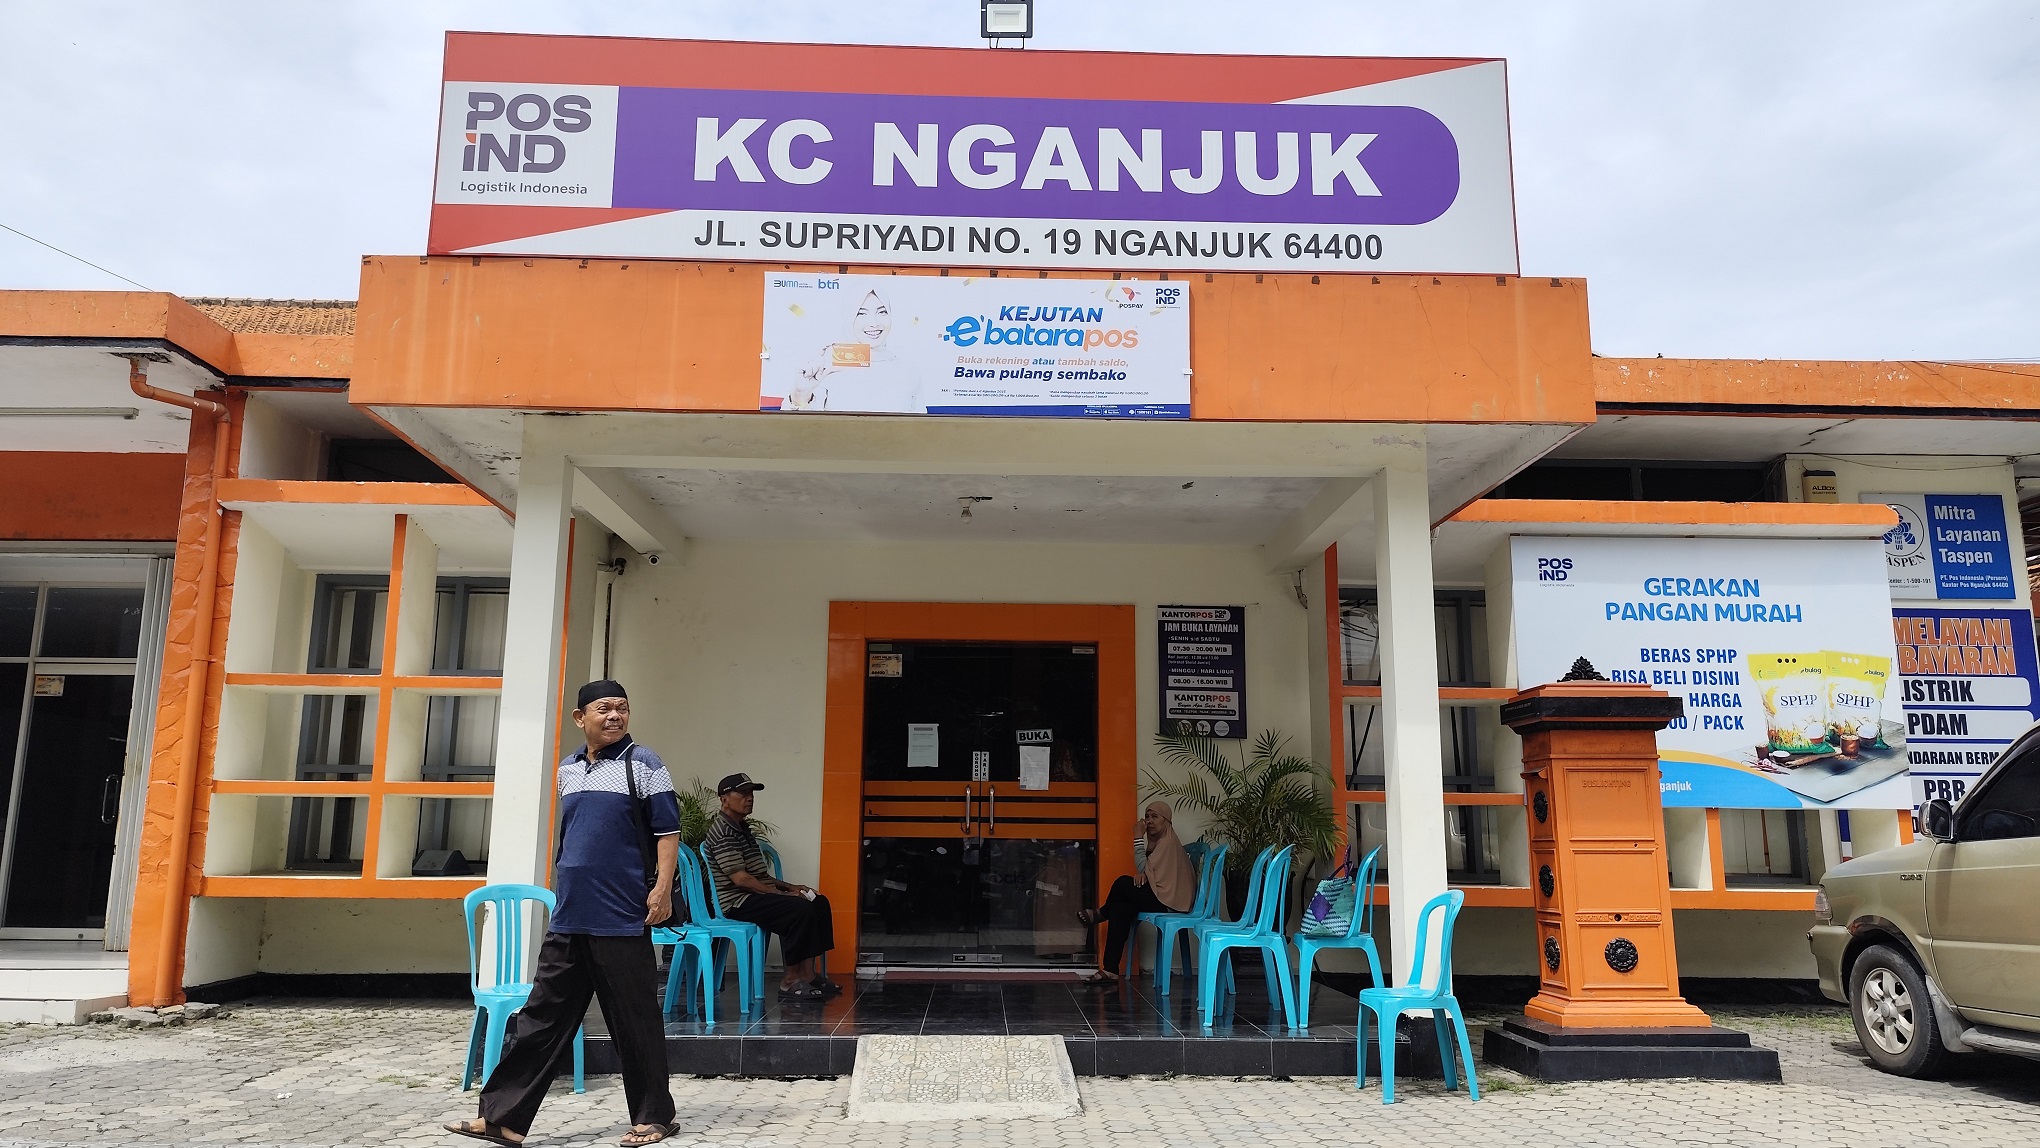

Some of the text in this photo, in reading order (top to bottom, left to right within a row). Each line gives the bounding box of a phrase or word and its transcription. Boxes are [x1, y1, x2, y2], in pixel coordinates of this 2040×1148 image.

[467, 91, 592, 134] POS
[693, 116, 1383, 198] KC NGANJUK
[460, 181, 588, 196] Logistik Indonesia
[693, 220, 1383, 261] JL. SUPRIYADI NO. 19 NGANJUK 64400
[1155, 288, 1181, 297] POS
[999, 305, 1104, 323] KEJUTAN
[957, 355, 1129, 368] Buka rekening atau tambah saldo,
[954, 366, 1127, 382] Bawa pulang sembako
[1933, 505, 1976, 521] Mitra
[1936, 526, 2001, 545] Layanan
[1538, 557, 1573, 570] POS
[1938, 548, 1993, 567] Taspen
[1644, 577, 1760, 598] GERAKAN
[1161, 611, 1213, 619] KANTORPOS
[1605, 602, 1802, 623] PANGAN MURAH
[1164, 622, 1239, 633] JAM BUKA LAYANAN
[1893, 617, 2013, 646] MELAYANI
[1640, 648, 1738, 664] BERAS SPHP
[1897, 645, 2017, 675] BAYARAN
[1611, 669, 1740, 686] BISA BELI DISINI
[1868, 669, 1885, 677] bulog
[1174, 694, 1232, 703] KANTORPOS
[1901, 680, 1975, 702] ISTRIK
[1688, 692, 1743, 708] HARGA
[1780, 694, 1818, 707] SPHP
[1836, 692, 1875, 708] SPHP
[1703, 715, 1745, 730] PACK
[1907, 713, 1969, 736] PDAM
[1018, 731, 1050, 742] BUKA
